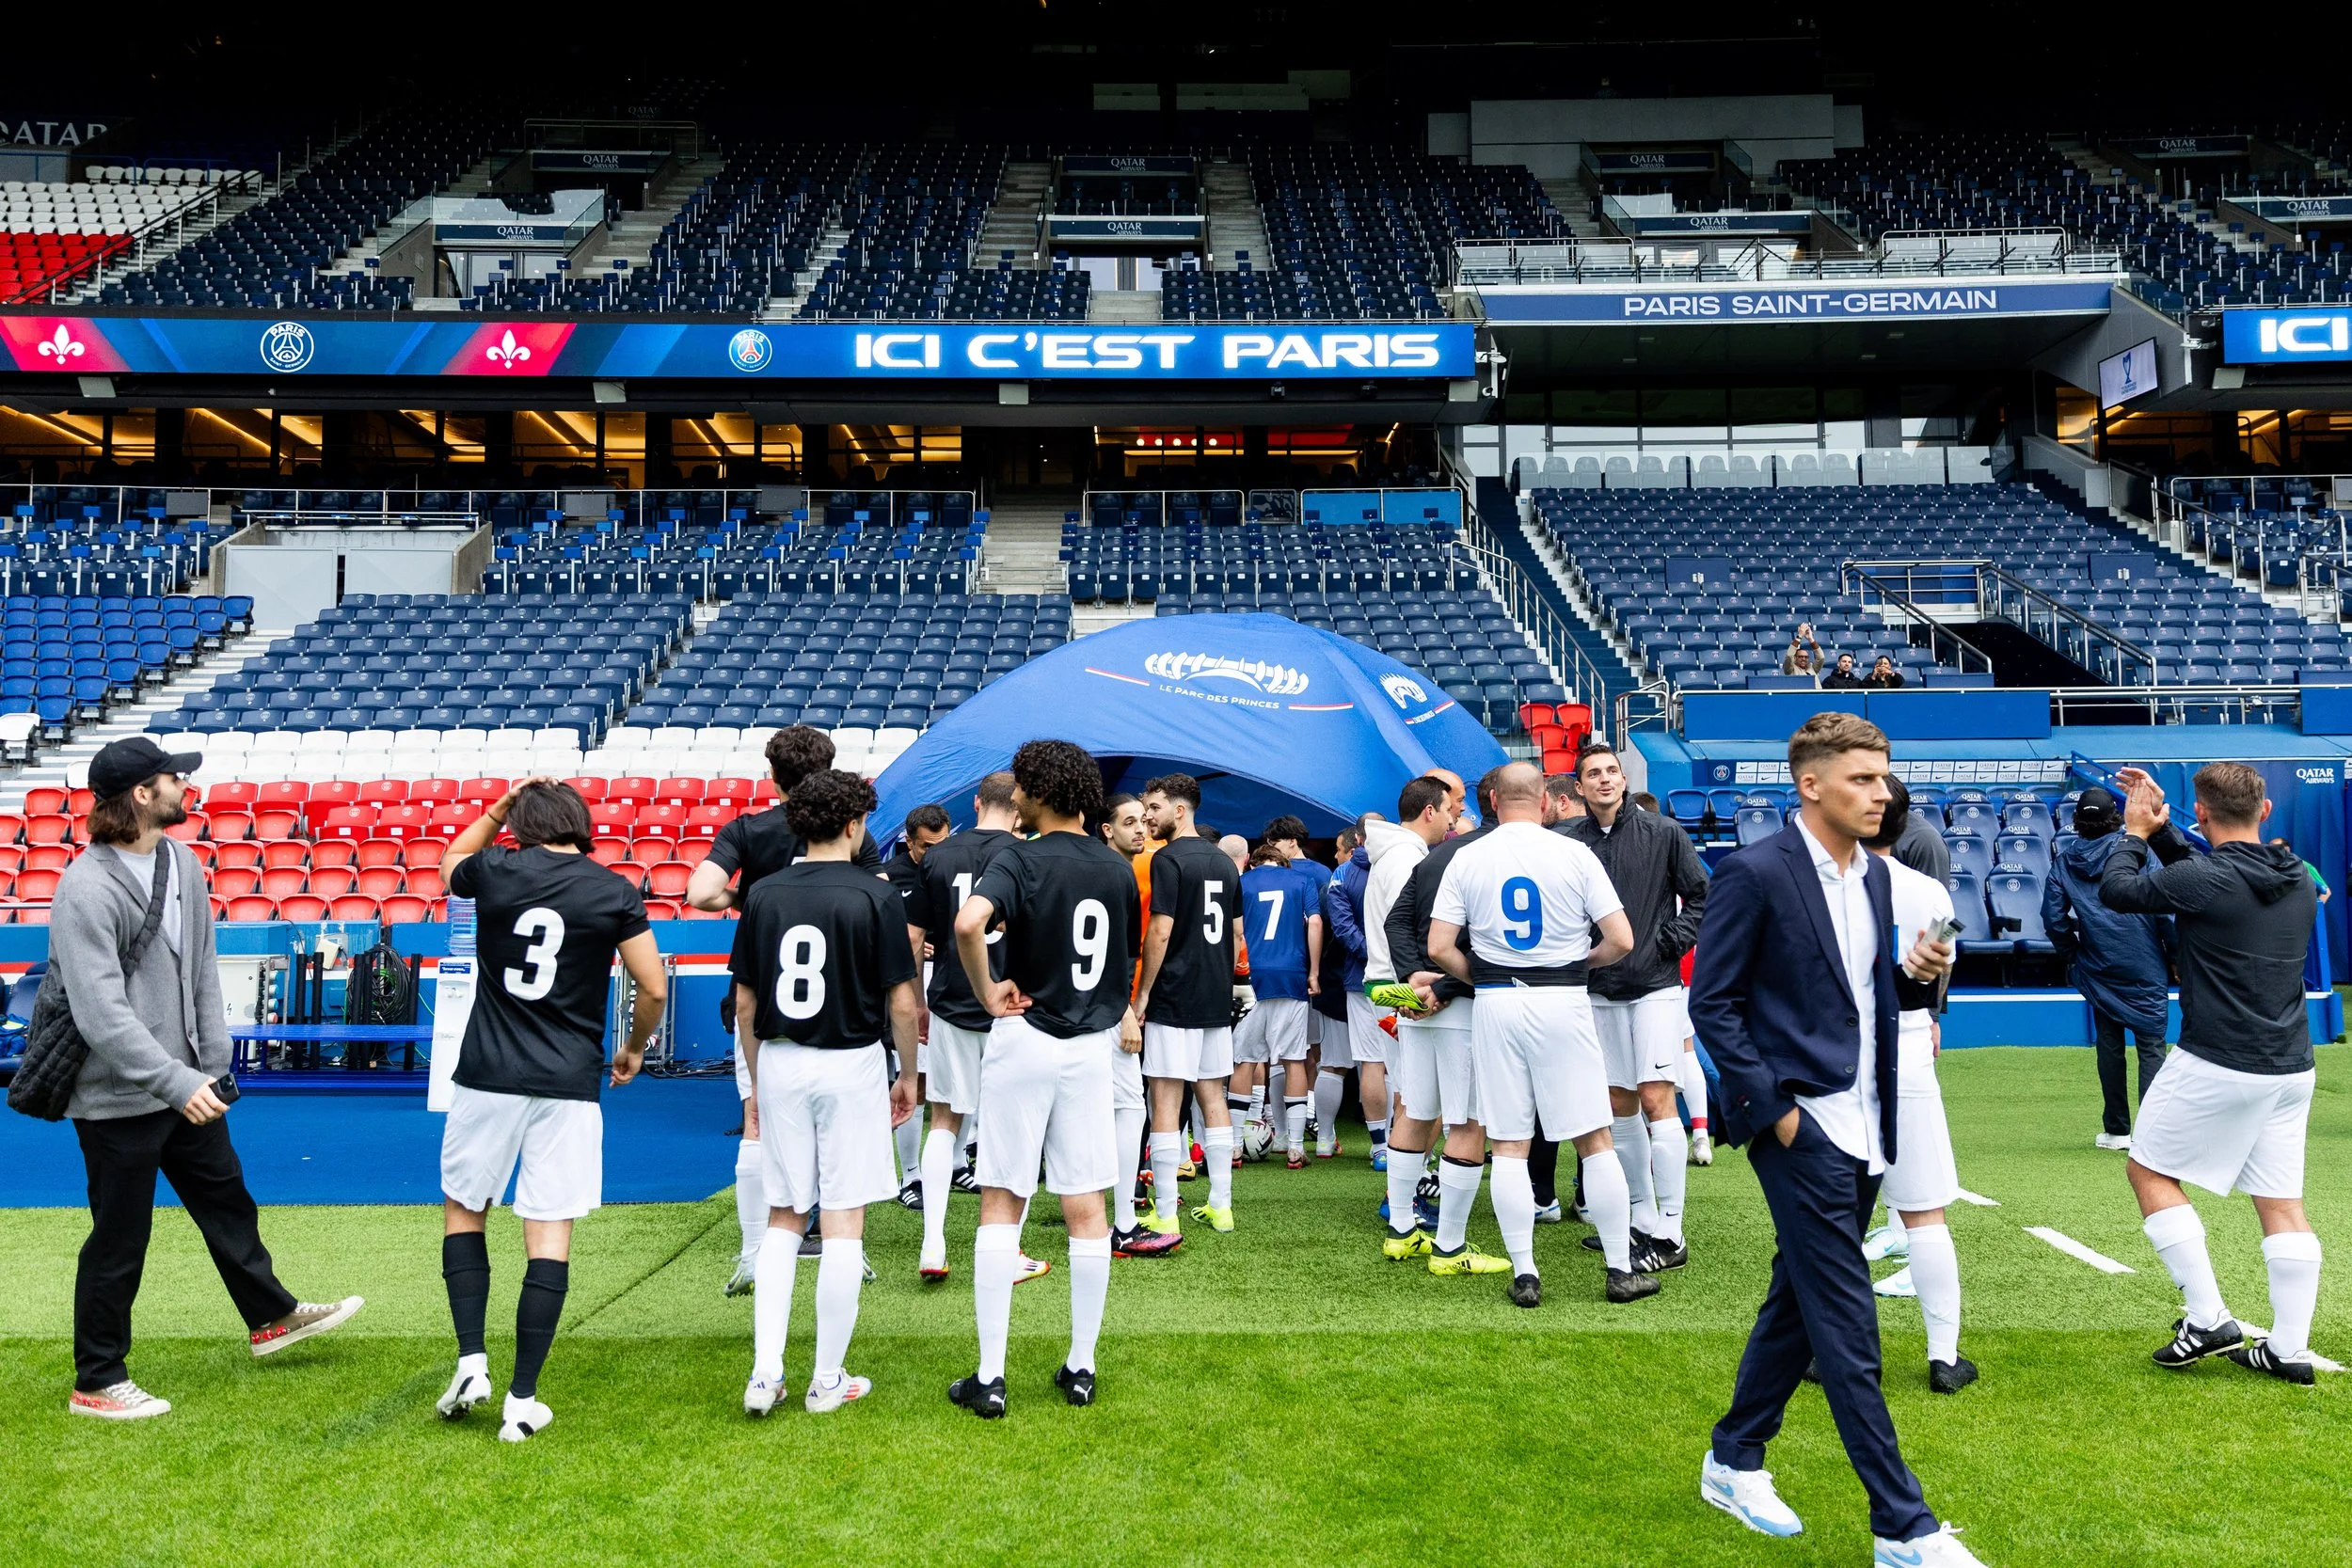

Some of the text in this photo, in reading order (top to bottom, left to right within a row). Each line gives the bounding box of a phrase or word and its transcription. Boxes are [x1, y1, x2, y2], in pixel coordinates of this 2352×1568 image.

[2159, 138, 2197, 150] QATAR
[583, 154, 619, 165] QATAR
[1110, 157, 1146, 168] QATAR
[1629, 154, 1665, 165] QATAR
[2286, 199, 2329, 213] QATAR
[1106, 221, 1142, 231] QATAR
[1690, 216, 1728, 228] QATAR
[497, 226, 534, 236] QATAR
[1624, 290, 1996, 316] PARIS SAINT-GERMAIN
[269, 324, 306, 338] PARIS
[736, 331, 765, 343] PARIS
[2260, 317, 2348, 353] ICI
[856, 332, 1439, 369] ICI C'EST PARIS
[1159, 685, 1279, 709] LE PARC DES PRINCES
[2296, 768, 2334, 780] QATAR
[1203, 879, 1223, 945] 5
[1258, 891, 1284, 941] 7
[1502, 876, 1543, 951] 9
[1072, 899, 1109, 991] 9
[503, 907, 565, 1001] 3
[776, 925, 827, 1020] 8
